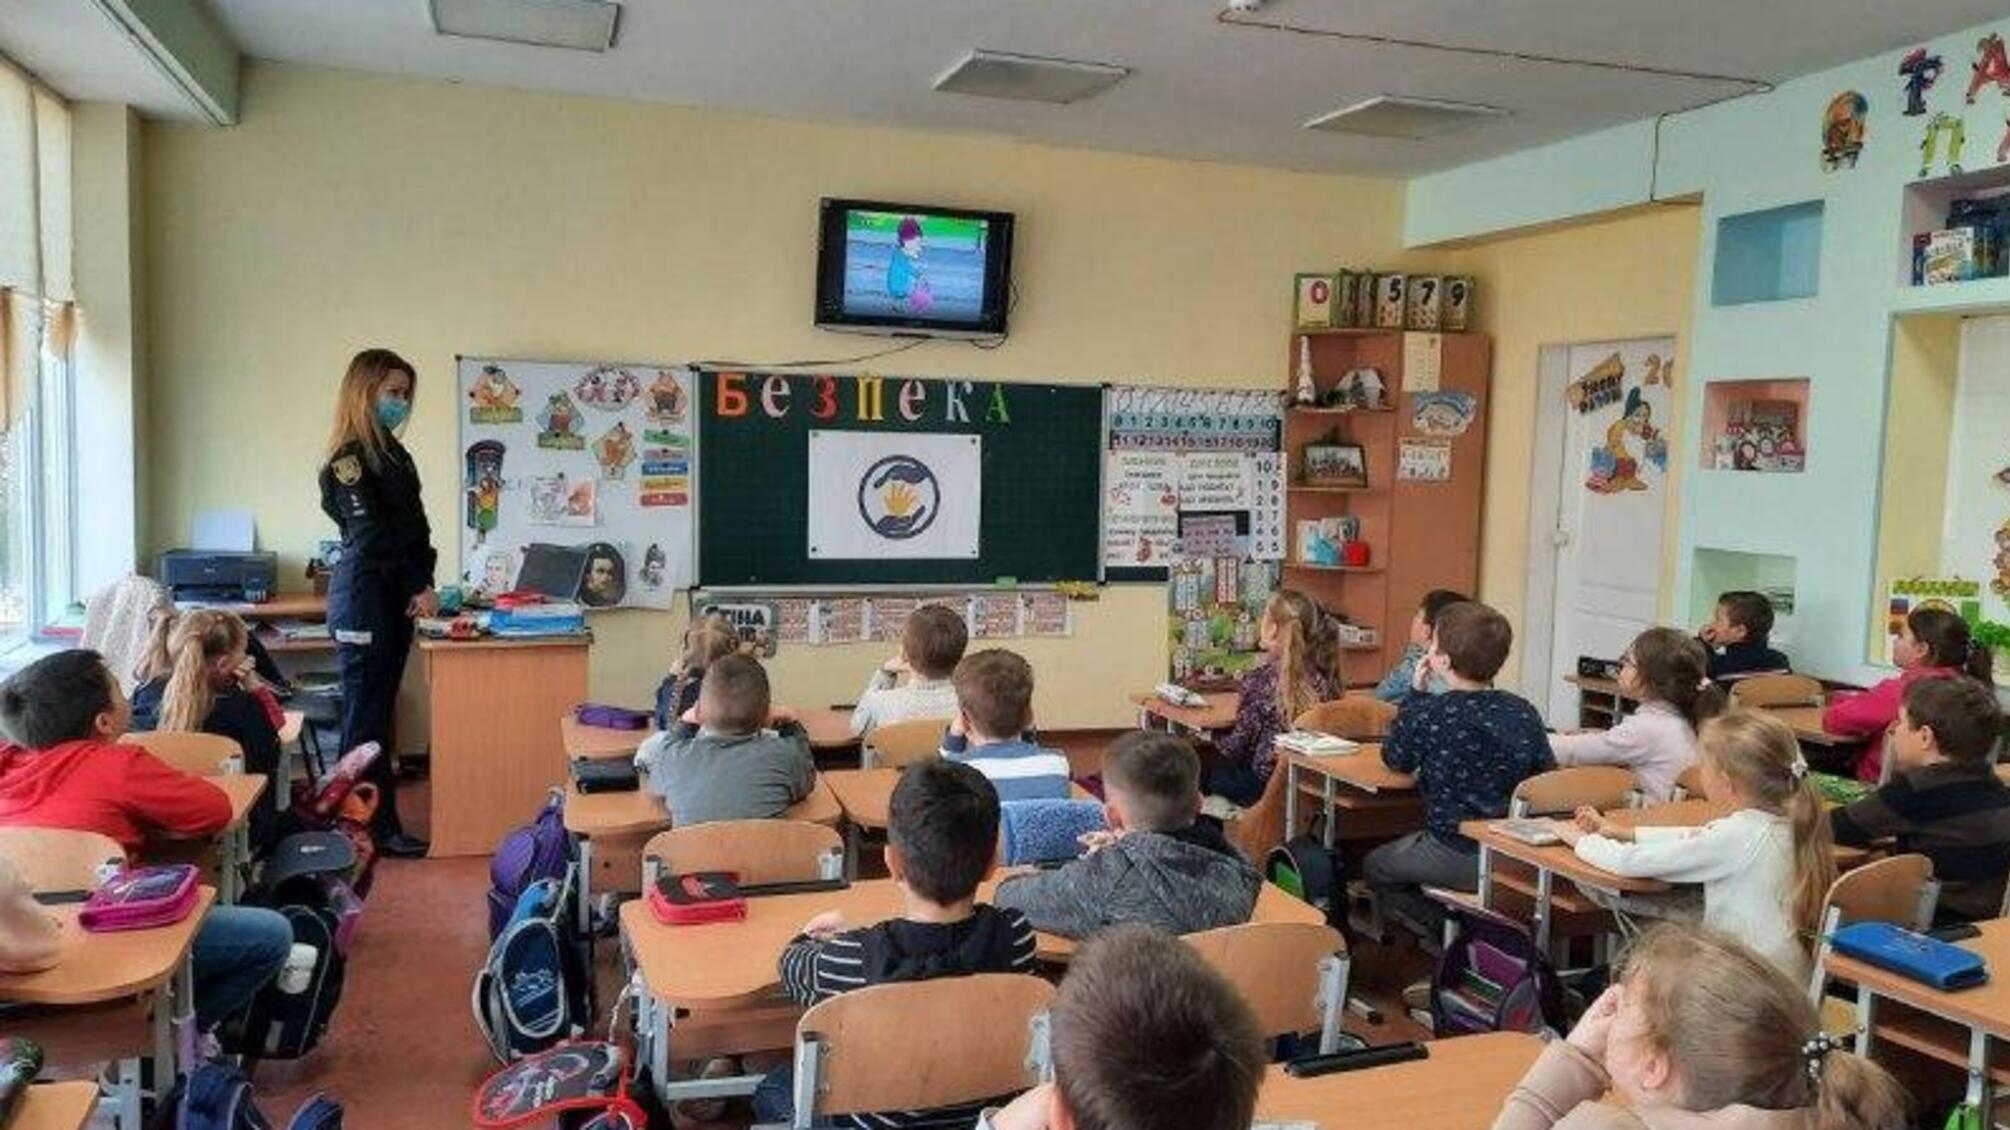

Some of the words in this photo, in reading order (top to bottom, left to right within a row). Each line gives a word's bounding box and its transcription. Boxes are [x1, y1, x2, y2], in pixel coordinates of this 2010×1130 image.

[1388, 278, 1401, 302] 5
[1421, 281, 1436, 306] 7
[1450, 283, 1465, 307] 9
[1145, 415, 1153, 428] 2
[1161, 415, 1169, 428] 3
[1257, 460, 1272, 474] 10
